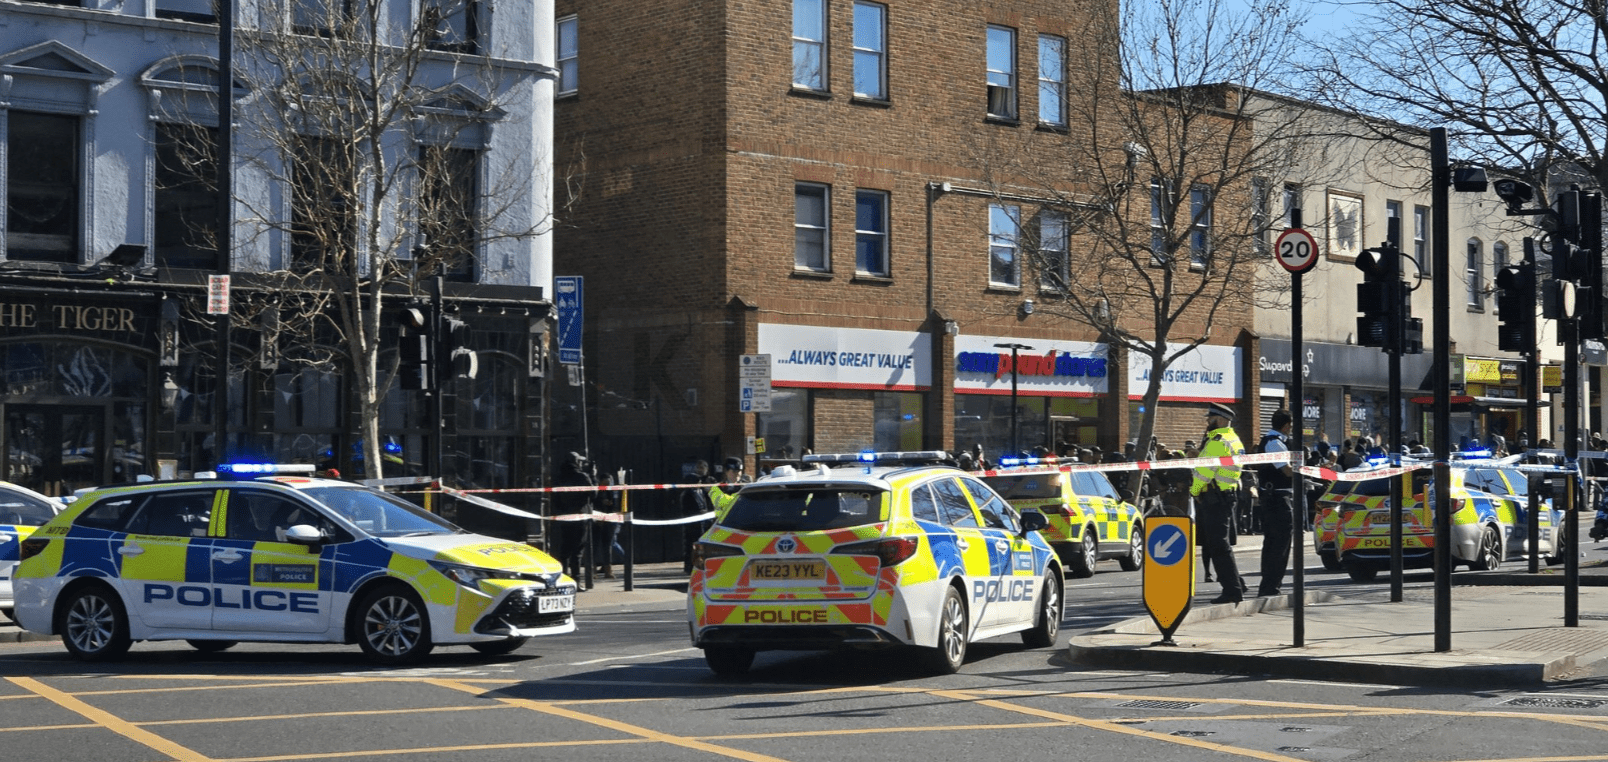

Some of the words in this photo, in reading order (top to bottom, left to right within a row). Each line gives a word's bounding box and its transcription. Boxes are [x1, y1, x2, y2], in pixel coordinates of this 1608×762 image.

[1280, 242, 1309, 258] 20
[0, 302, 36, 328] HE
[52, 305, 136, 332] TIGER
[839, 352, 875, 368] GREAT
[878, 354, 912, 369] VALUE
[1259, 356, 1310, 377] Superdg
[1175, 370, 1198, 382] GREAT
[1200, 372, 1224, 384] VALUE
[756, 564, 790, 578] KE23
[794, 564, 818, 577] YYL
[144, 584, 319, 614] POLICE
[973, 580, 1034, 604] POLICE
[744, 610, 828, 623] POLICE
